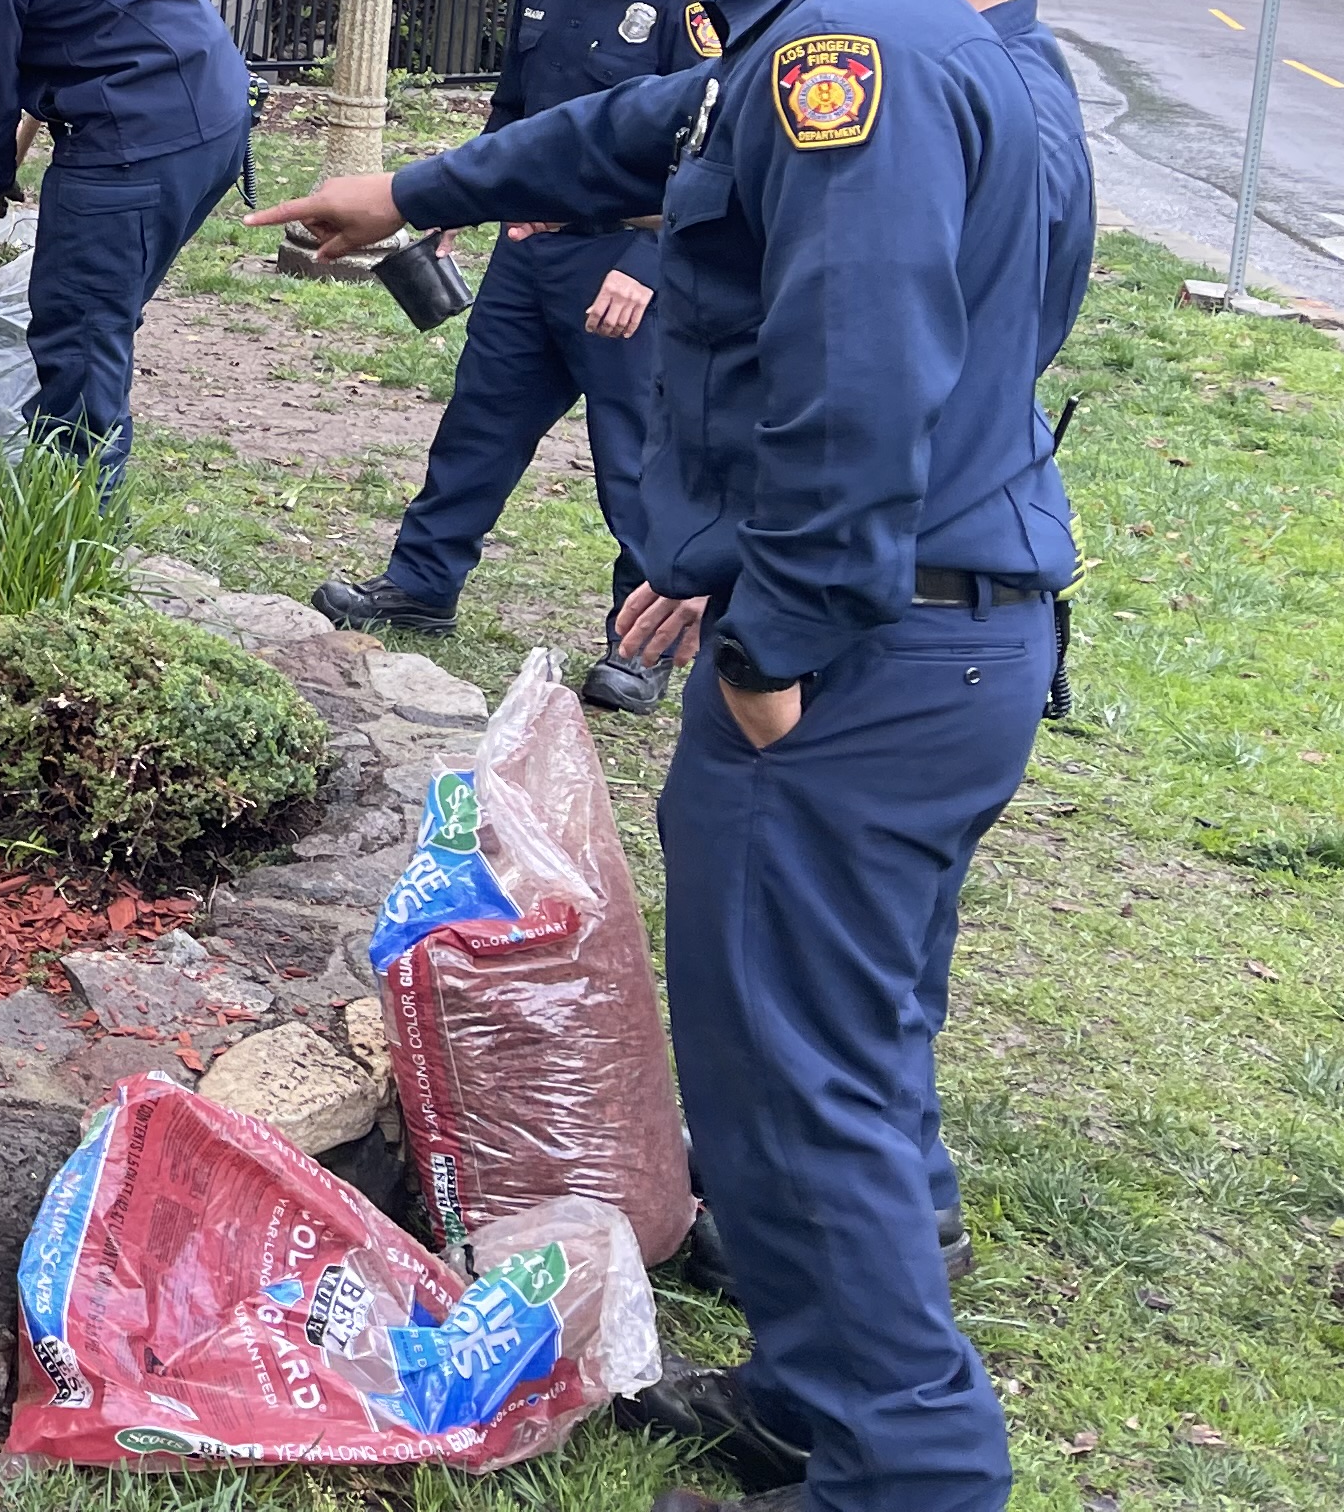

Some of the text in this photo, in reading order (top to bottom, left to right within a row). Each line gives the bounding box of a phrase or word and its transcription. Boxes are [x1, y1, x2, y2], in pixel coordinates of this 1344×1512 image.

[780, 40, 870, 65] LOS ANGELES
[807, 52, 839, 67] FIRE
[798, 124, 862, 141] DEPARTMENT
[471, 932, 510, 950] OLOR
[259, 1198, 290, 1287] YEAR-LONG
[326, 1276, 365, 1353] BEST
[44, 1339, 91, 1409] BEST
